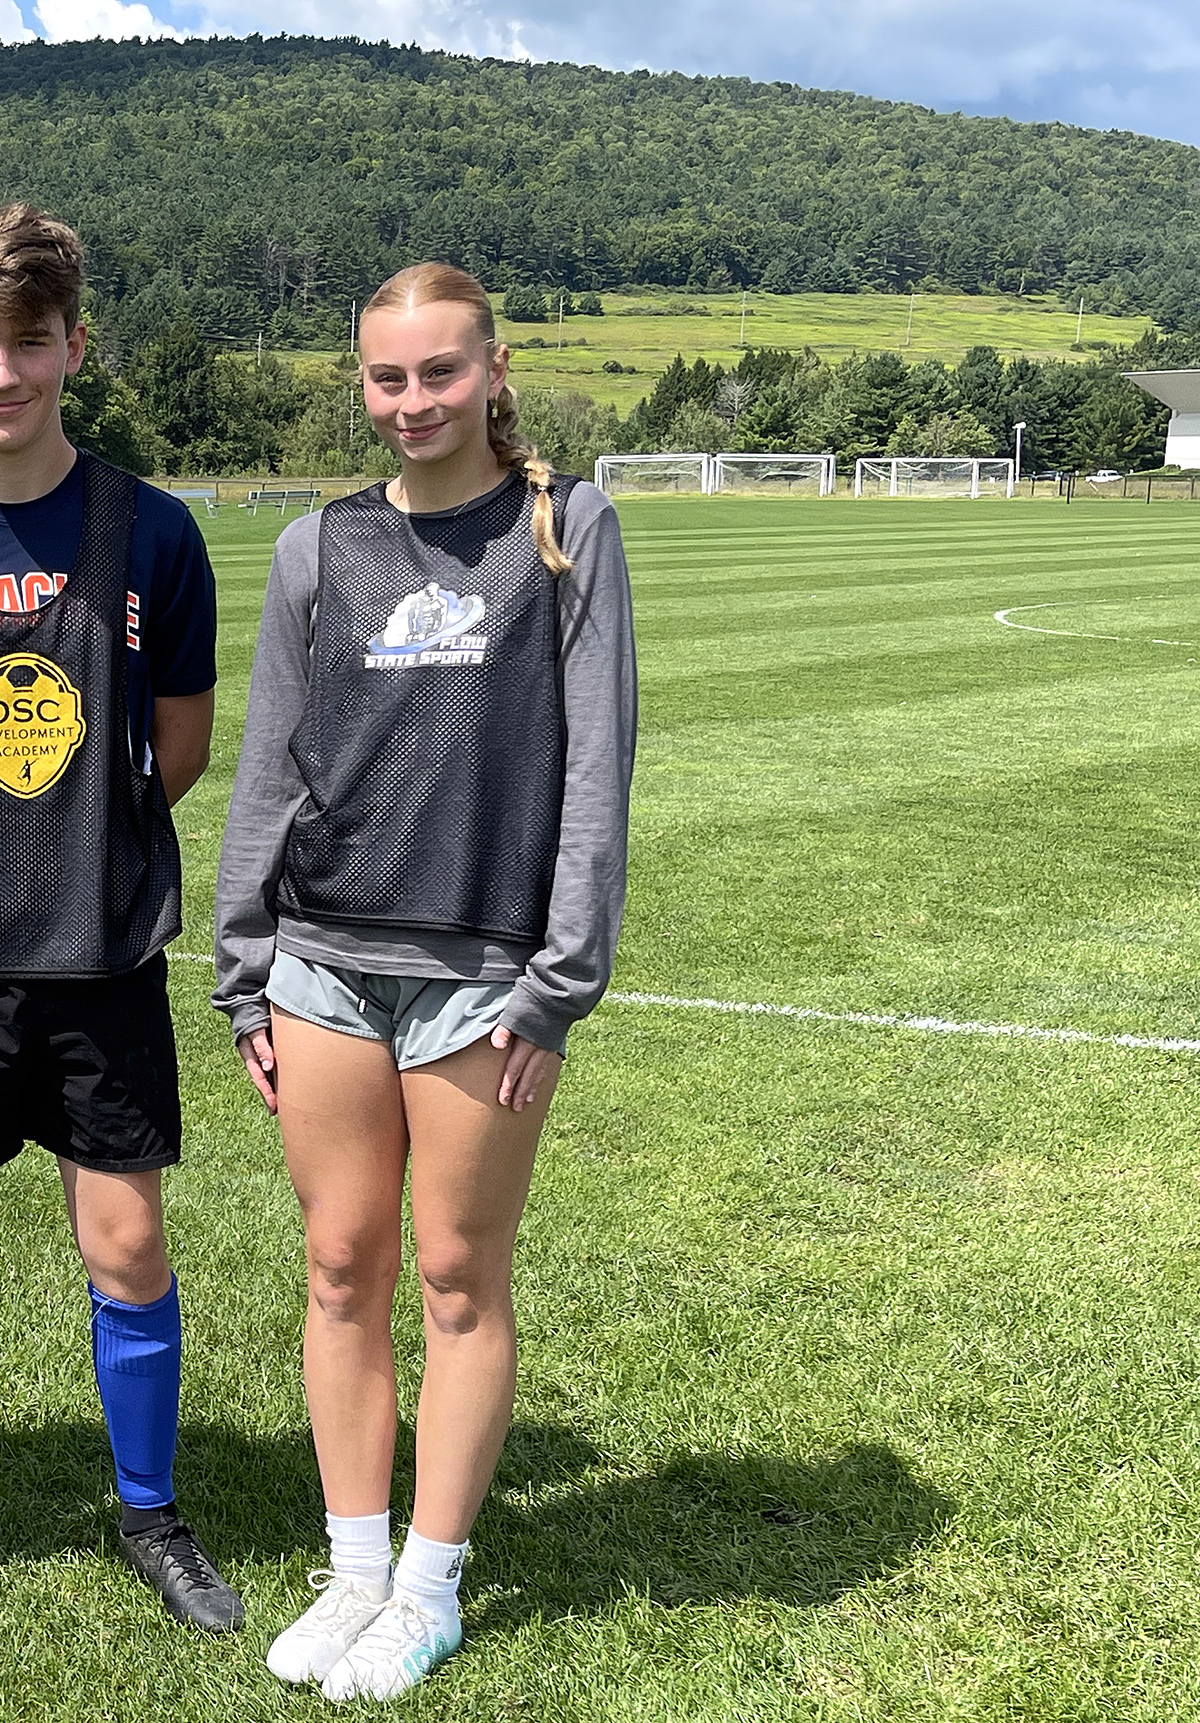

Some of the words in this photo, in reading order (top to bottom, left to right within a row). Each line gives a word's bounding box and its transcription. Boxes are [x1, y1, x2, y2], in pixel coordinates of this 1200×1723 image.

[439, 636, 488, 650] FLOW
[364, 653, 417, 669] STATE
[419, 651, 486, 666] SPORTS
